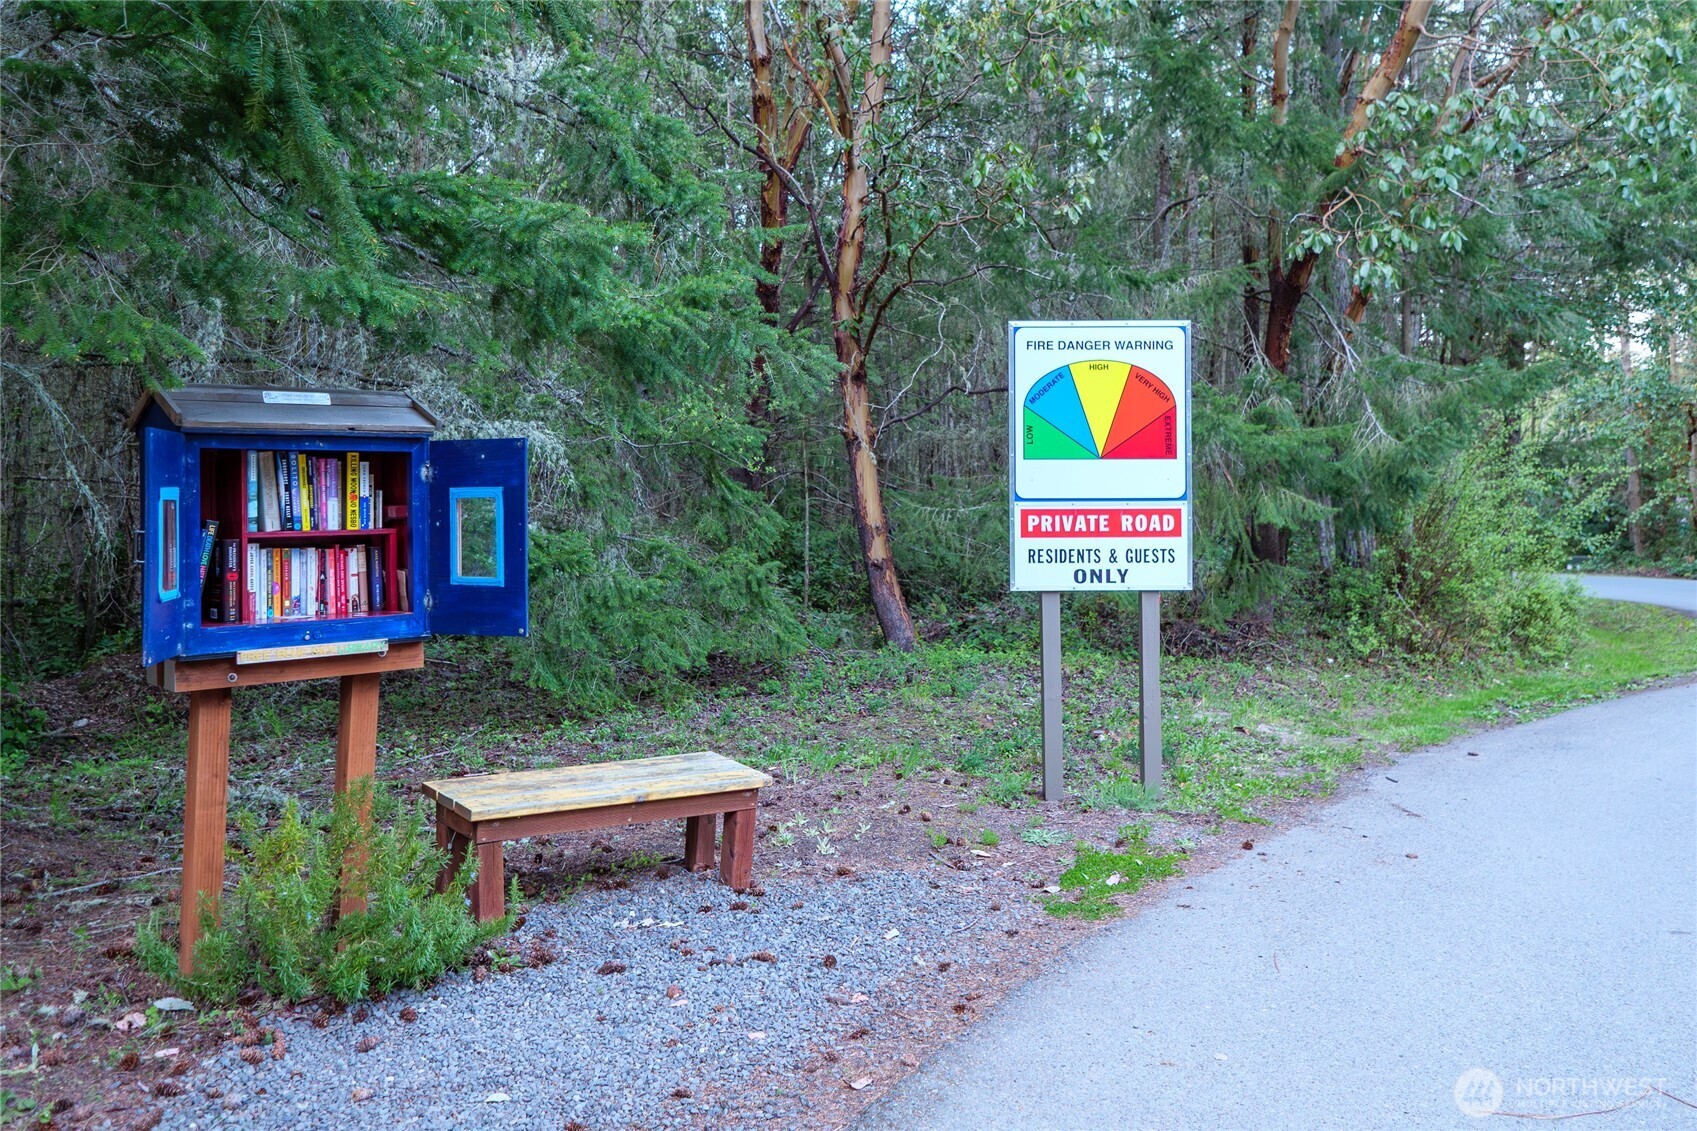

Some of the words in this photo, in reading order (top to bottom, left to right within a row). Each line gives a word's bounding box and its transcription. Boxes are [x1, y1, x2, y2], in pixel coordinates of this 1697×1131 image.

[1026, 340, 1054, 350] FIRE
[1057, 340, 1110, 350] DANGER
[1114, 340, 1174, 350] WARNING
[1089, 363, 1109, 371] HIGH
[1029, 371, 1065, 405] MODERATE
[1134, 372, 1154, 390] VERY
[1152, 387, 1171, 404] HIGH
[1026, 424, 1034, 445] LOW
[1164, 415, 1173, 456] EXTREME
[290, 454, 298, 487] SOLITO
[207, 524, 216, 536] LIFE
[1027, 514, 1110, 532] PRIVATE
[1121, 514, 1175, 532] ROAD
[204, 535, 213, 553] DEATH
[200, 552, 209, 566] LOVE
[1028, 548, 1101, 564] RESIDENTS
[1108, 548, 1118, 564] &
[1125, 548, 1176, 564] GUESTS
[1073, 568, 1129, 584] ONLY
